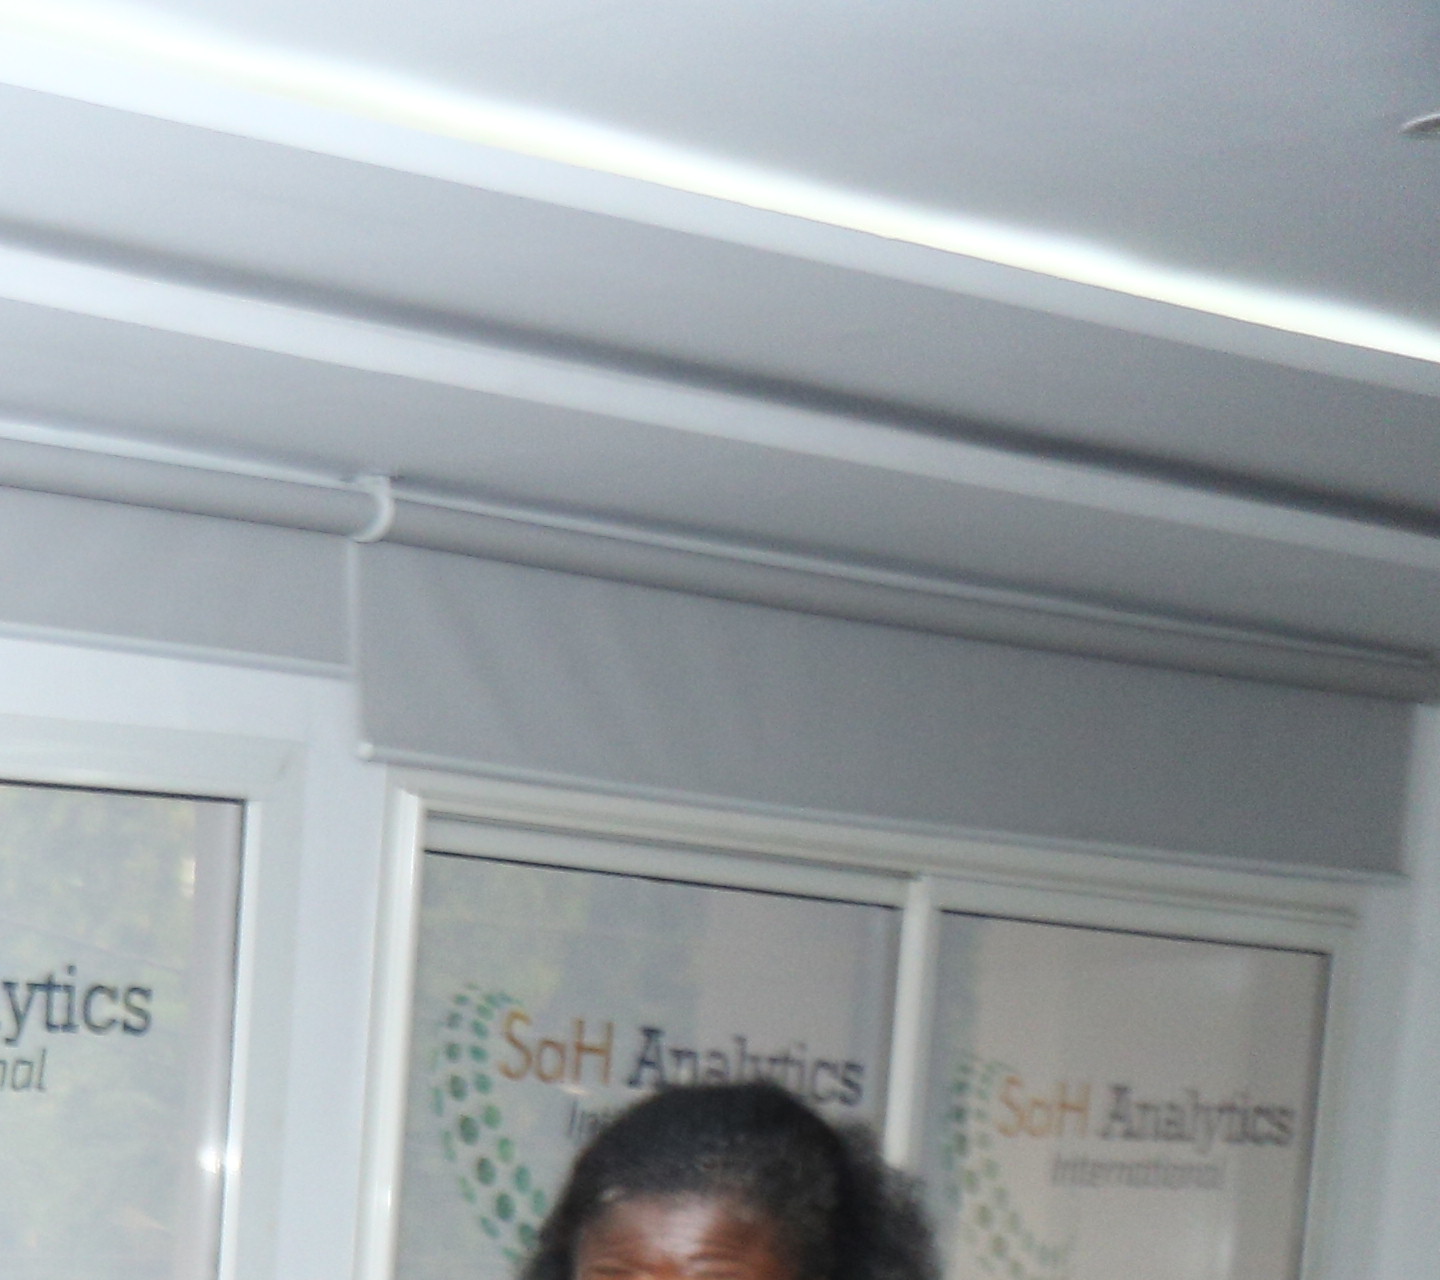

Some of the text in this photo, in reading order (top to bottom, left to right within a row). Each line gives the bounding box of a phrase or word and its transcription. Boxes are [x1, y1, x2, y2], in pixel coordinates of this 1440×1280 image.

[499, 1010, 616, 1087] SaH
[997, 1076, 1297, 1155] SaH Analytics
